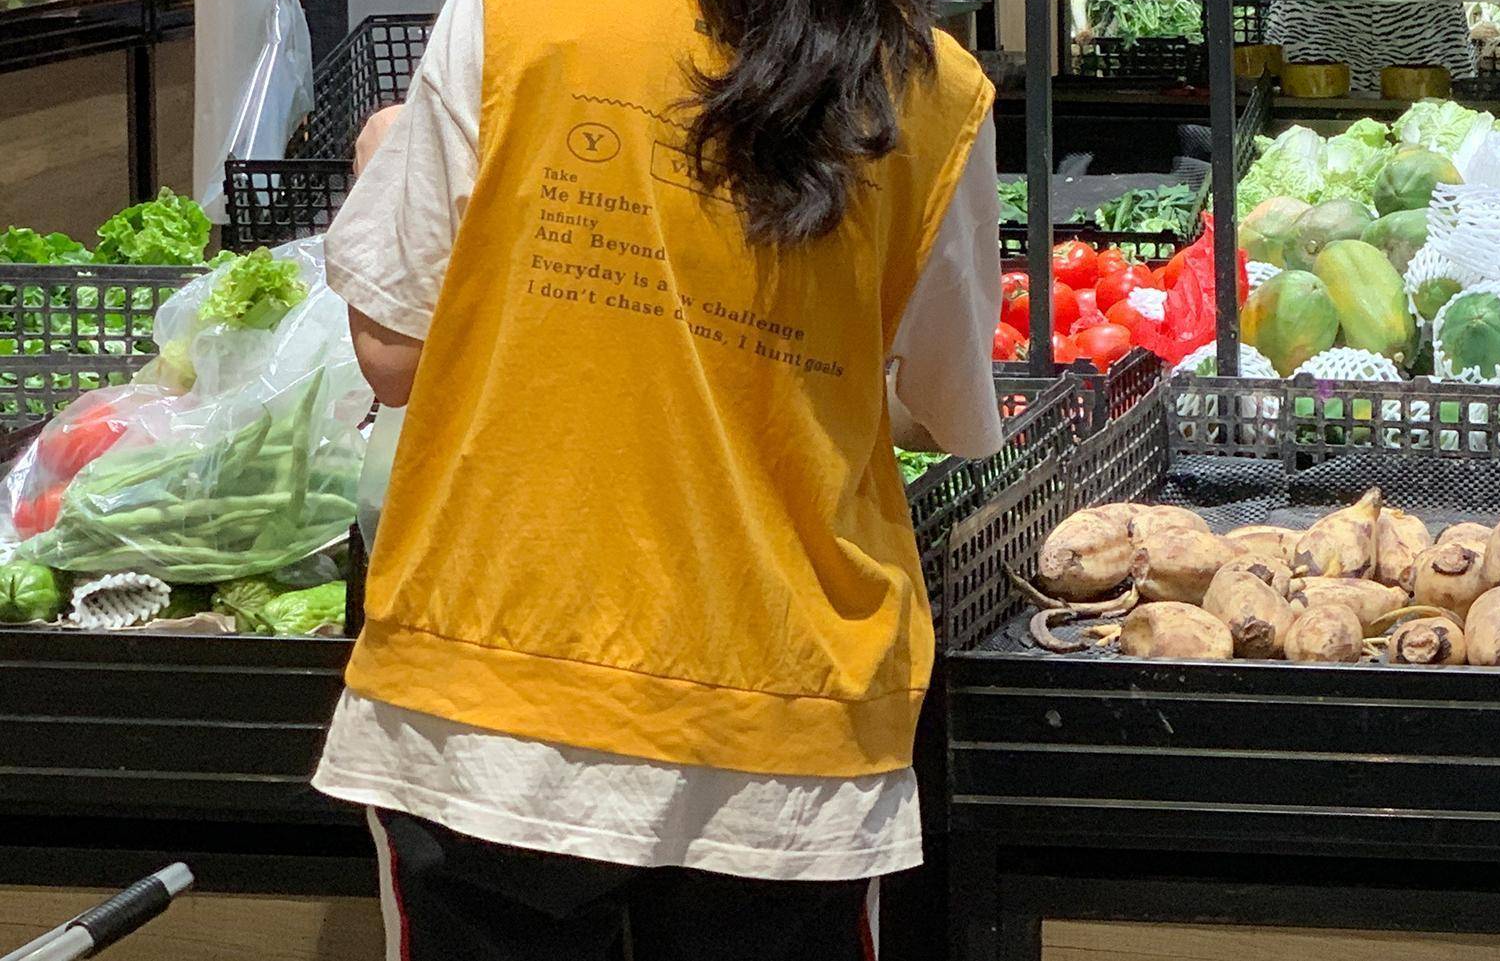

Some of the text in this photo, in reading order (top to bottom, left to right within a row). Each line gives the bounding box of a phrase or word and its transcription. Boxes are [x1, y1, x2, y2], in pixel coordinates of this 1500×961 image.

[583, 131, 604, 152] Y
[544, 167, 578, 183] Take
[540, 184, 653, 216] Me Higher
[540, 208, 599, 230] Infinity
[534, 225, 666, 261] And Beyond
[531, 253, 626, 286] Everyday
[633, 271, 649, 288] is
[656, 279, 668, 292] a
[702, 301, 805, 341] challenge
[527, 279, 535, 294] I
[540, 283, 597, 304] don't
[605, 293, 665, 317] chase
[737, 334, 746, 350] I
[754, 340, 801, 367] hunt
[804, 357, 844, 377] goals
